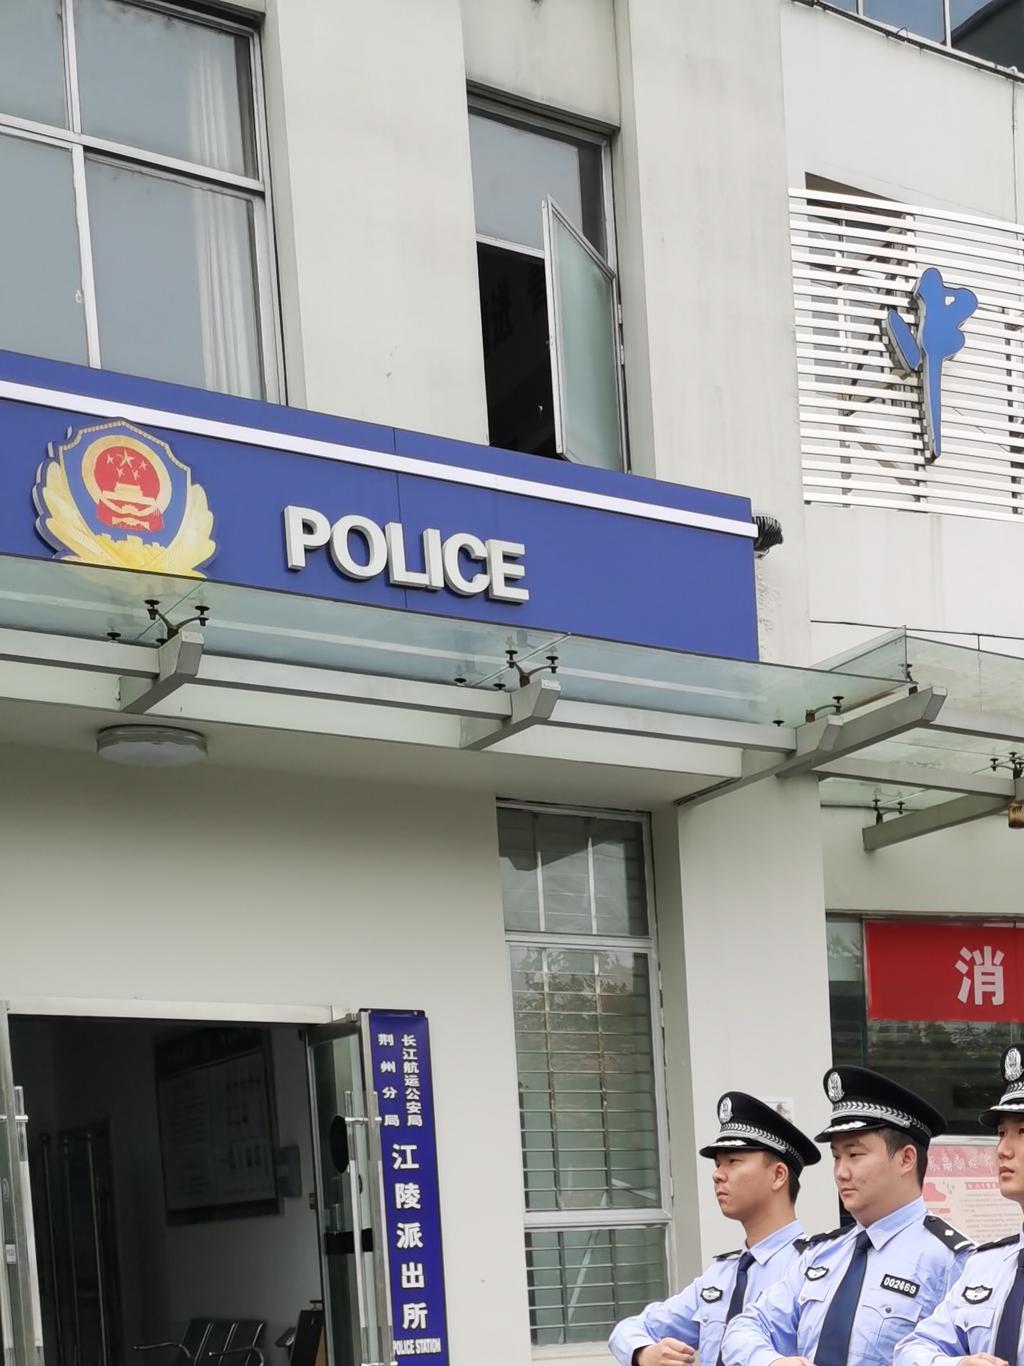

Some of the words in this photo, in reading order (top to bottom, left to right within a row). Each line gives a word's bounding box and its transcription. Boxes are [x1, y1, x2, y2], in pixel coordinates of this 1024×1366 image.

[284, 505, 530, 604] POLICE
[378, 1033, 400, 1127] 荆州分局
[401, 1034, 423, 1127] 长江航运公安局
[391, 1143, 428, 1329] 江陵派出所
[883, 1276, 917, 1294] 002469
[392, 1339, 415, 1355] POLICE
[415, 1337, 441, 1354] STATION
